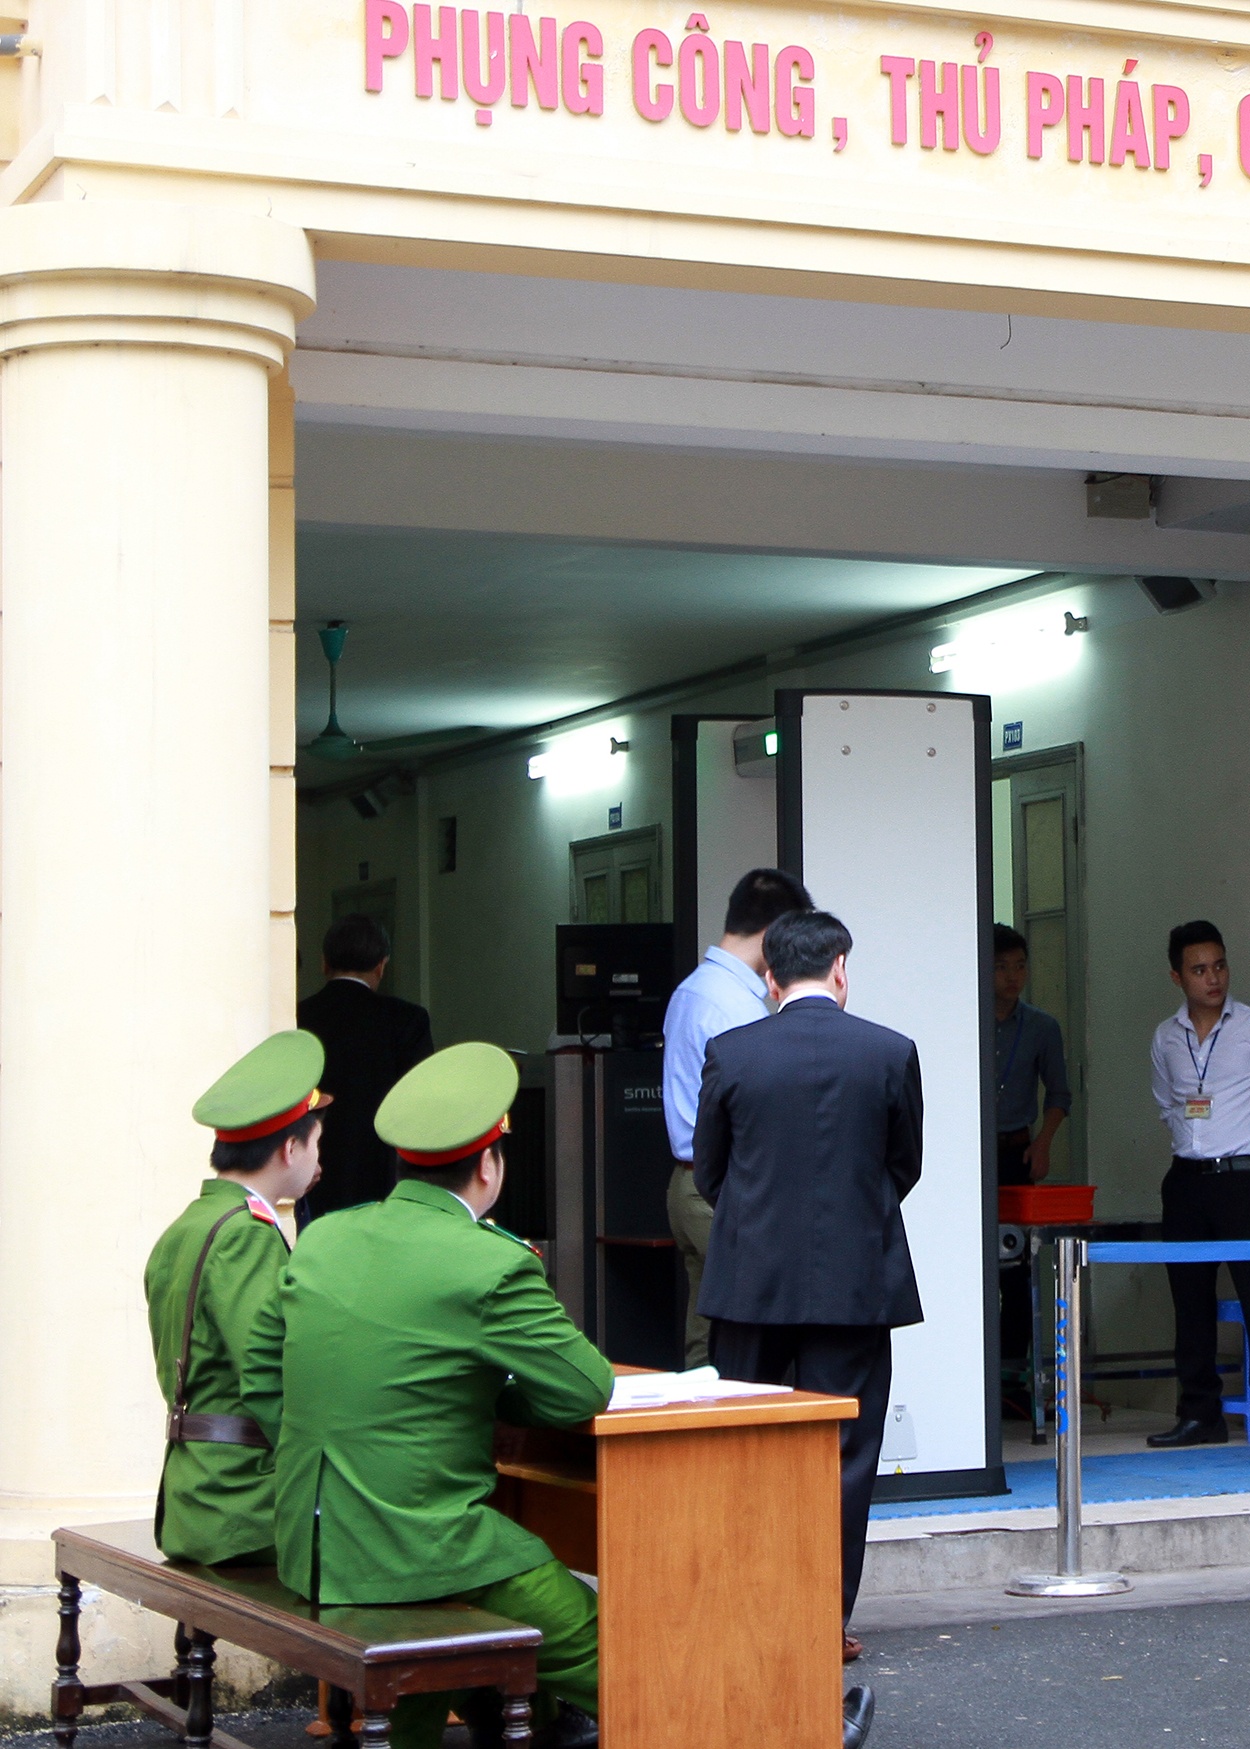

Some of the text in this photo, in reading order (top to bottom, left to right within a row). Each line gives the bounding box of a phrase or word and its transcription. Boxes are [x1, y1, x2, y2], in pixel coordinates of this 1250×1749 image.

[364, 0, 604, 127] PHỤNG
[880, 31, 1003, 156] THỦ
[624, 1086, 663, 1099] smit
